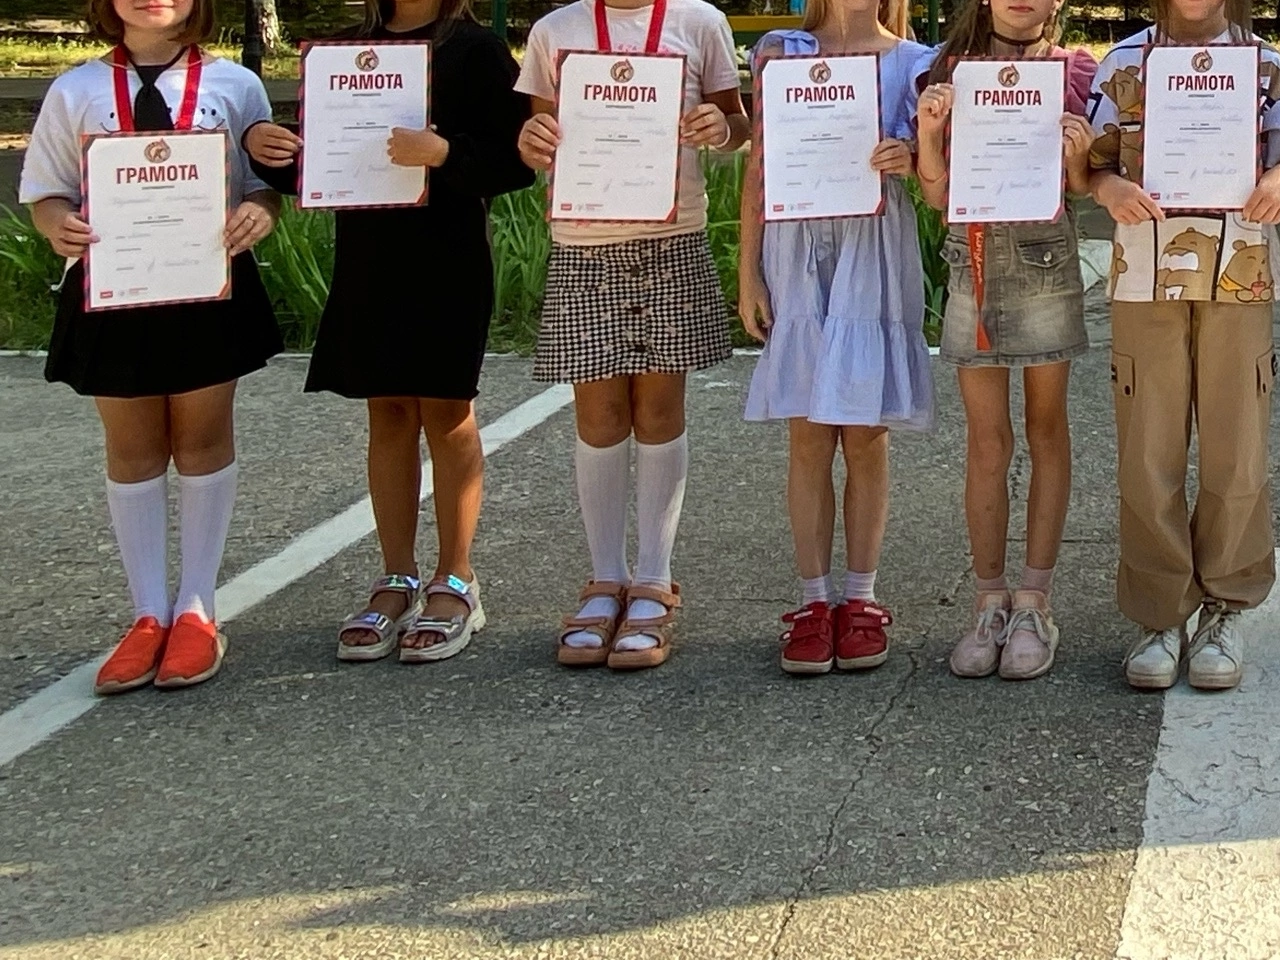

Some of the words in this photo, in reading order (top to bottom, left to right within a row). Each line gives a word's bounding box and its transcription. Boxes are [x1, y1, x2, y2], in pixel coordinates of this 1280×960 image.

[329, 73, 403, 91] ГРАМОТА
[1168, 74, 1235, 92] ГРАМОТА
[584, 84, 657, 103] ГРАМОТА
[786, 84, 856, 104] ГРАМОТА
[974, 89, 1042, 106] ГРАМОТА
[116, 164, 199, 185] ГРАМОТА
